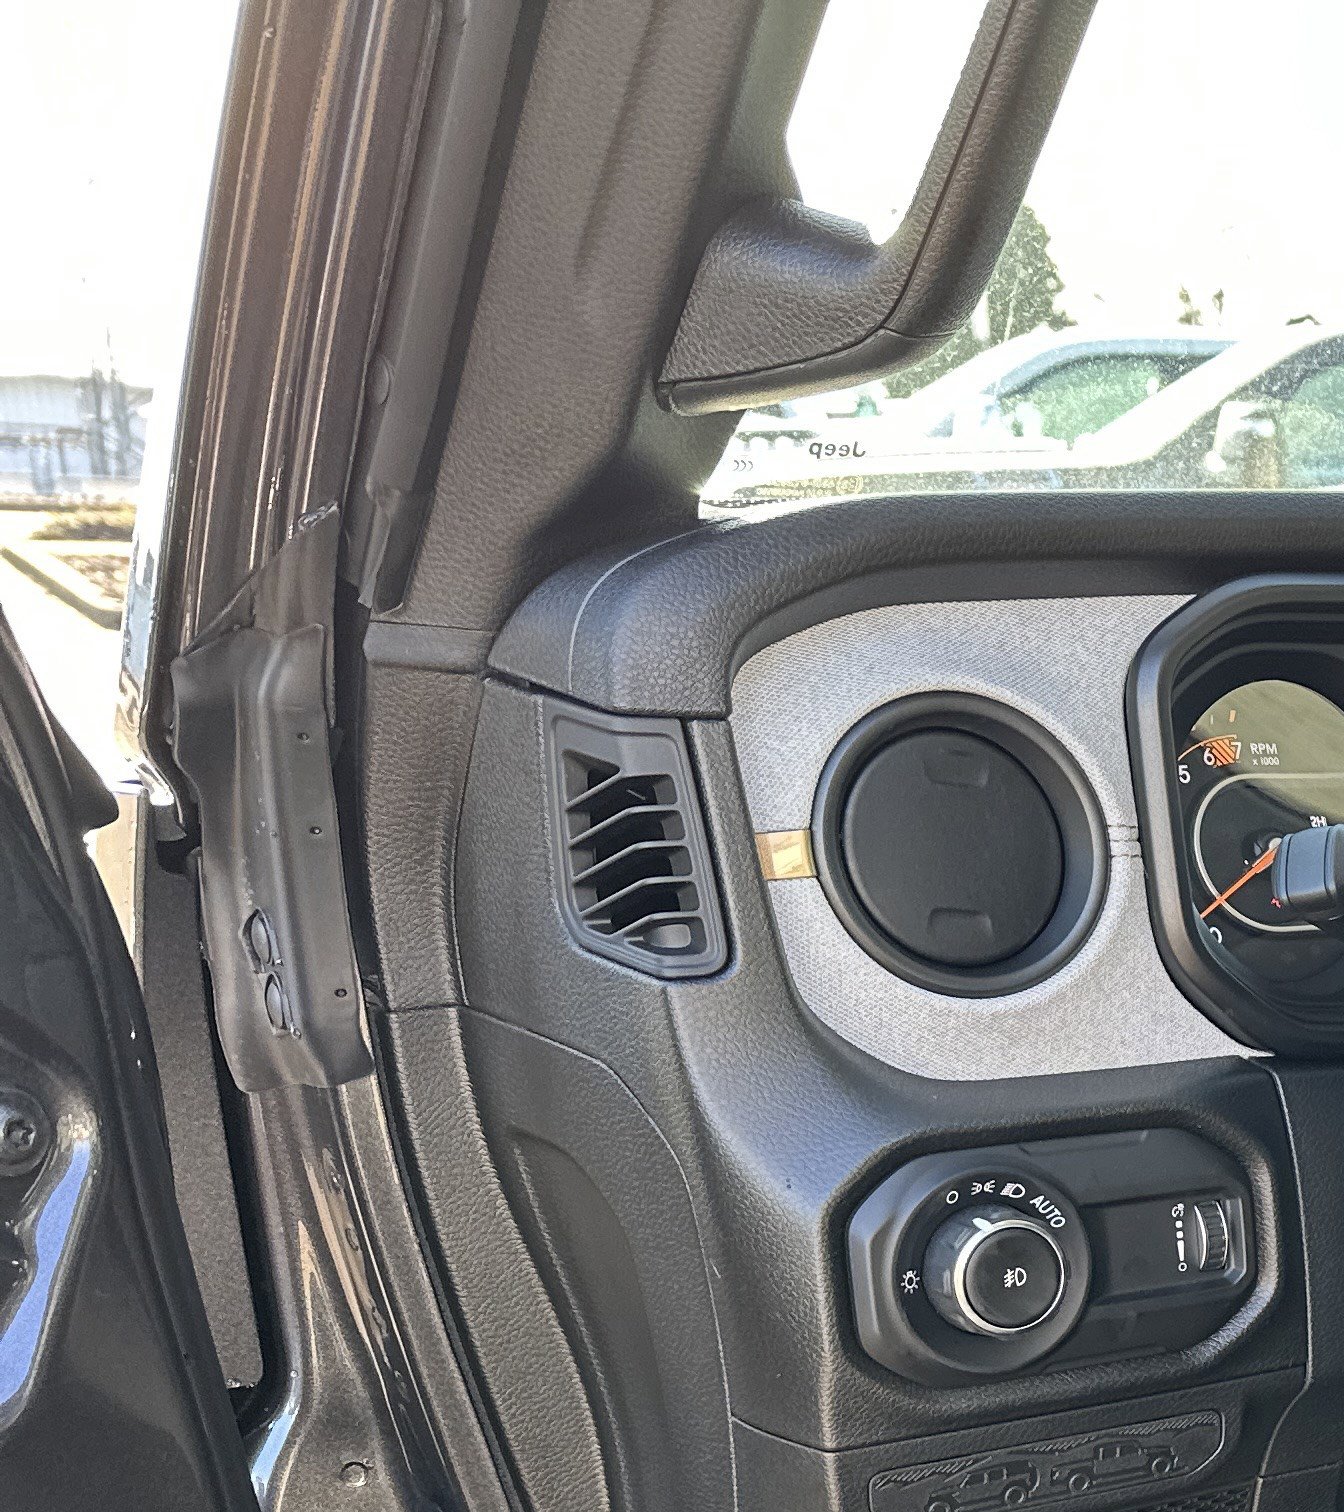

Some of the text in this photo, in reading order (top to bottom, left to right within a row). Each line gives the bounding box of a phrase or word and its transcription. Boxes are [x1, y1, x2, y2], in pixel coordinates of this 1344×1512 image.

[1203, 748, 1215, 766] 6
[1231, 742, 1242, 760] 7
[1250, 743, 1278, 755] RPM
[1260, 757, 1280, 766] 1000
[1178, 765, 1191, 784] 5
[1029, 1195, 1066, 1228] AUTO
